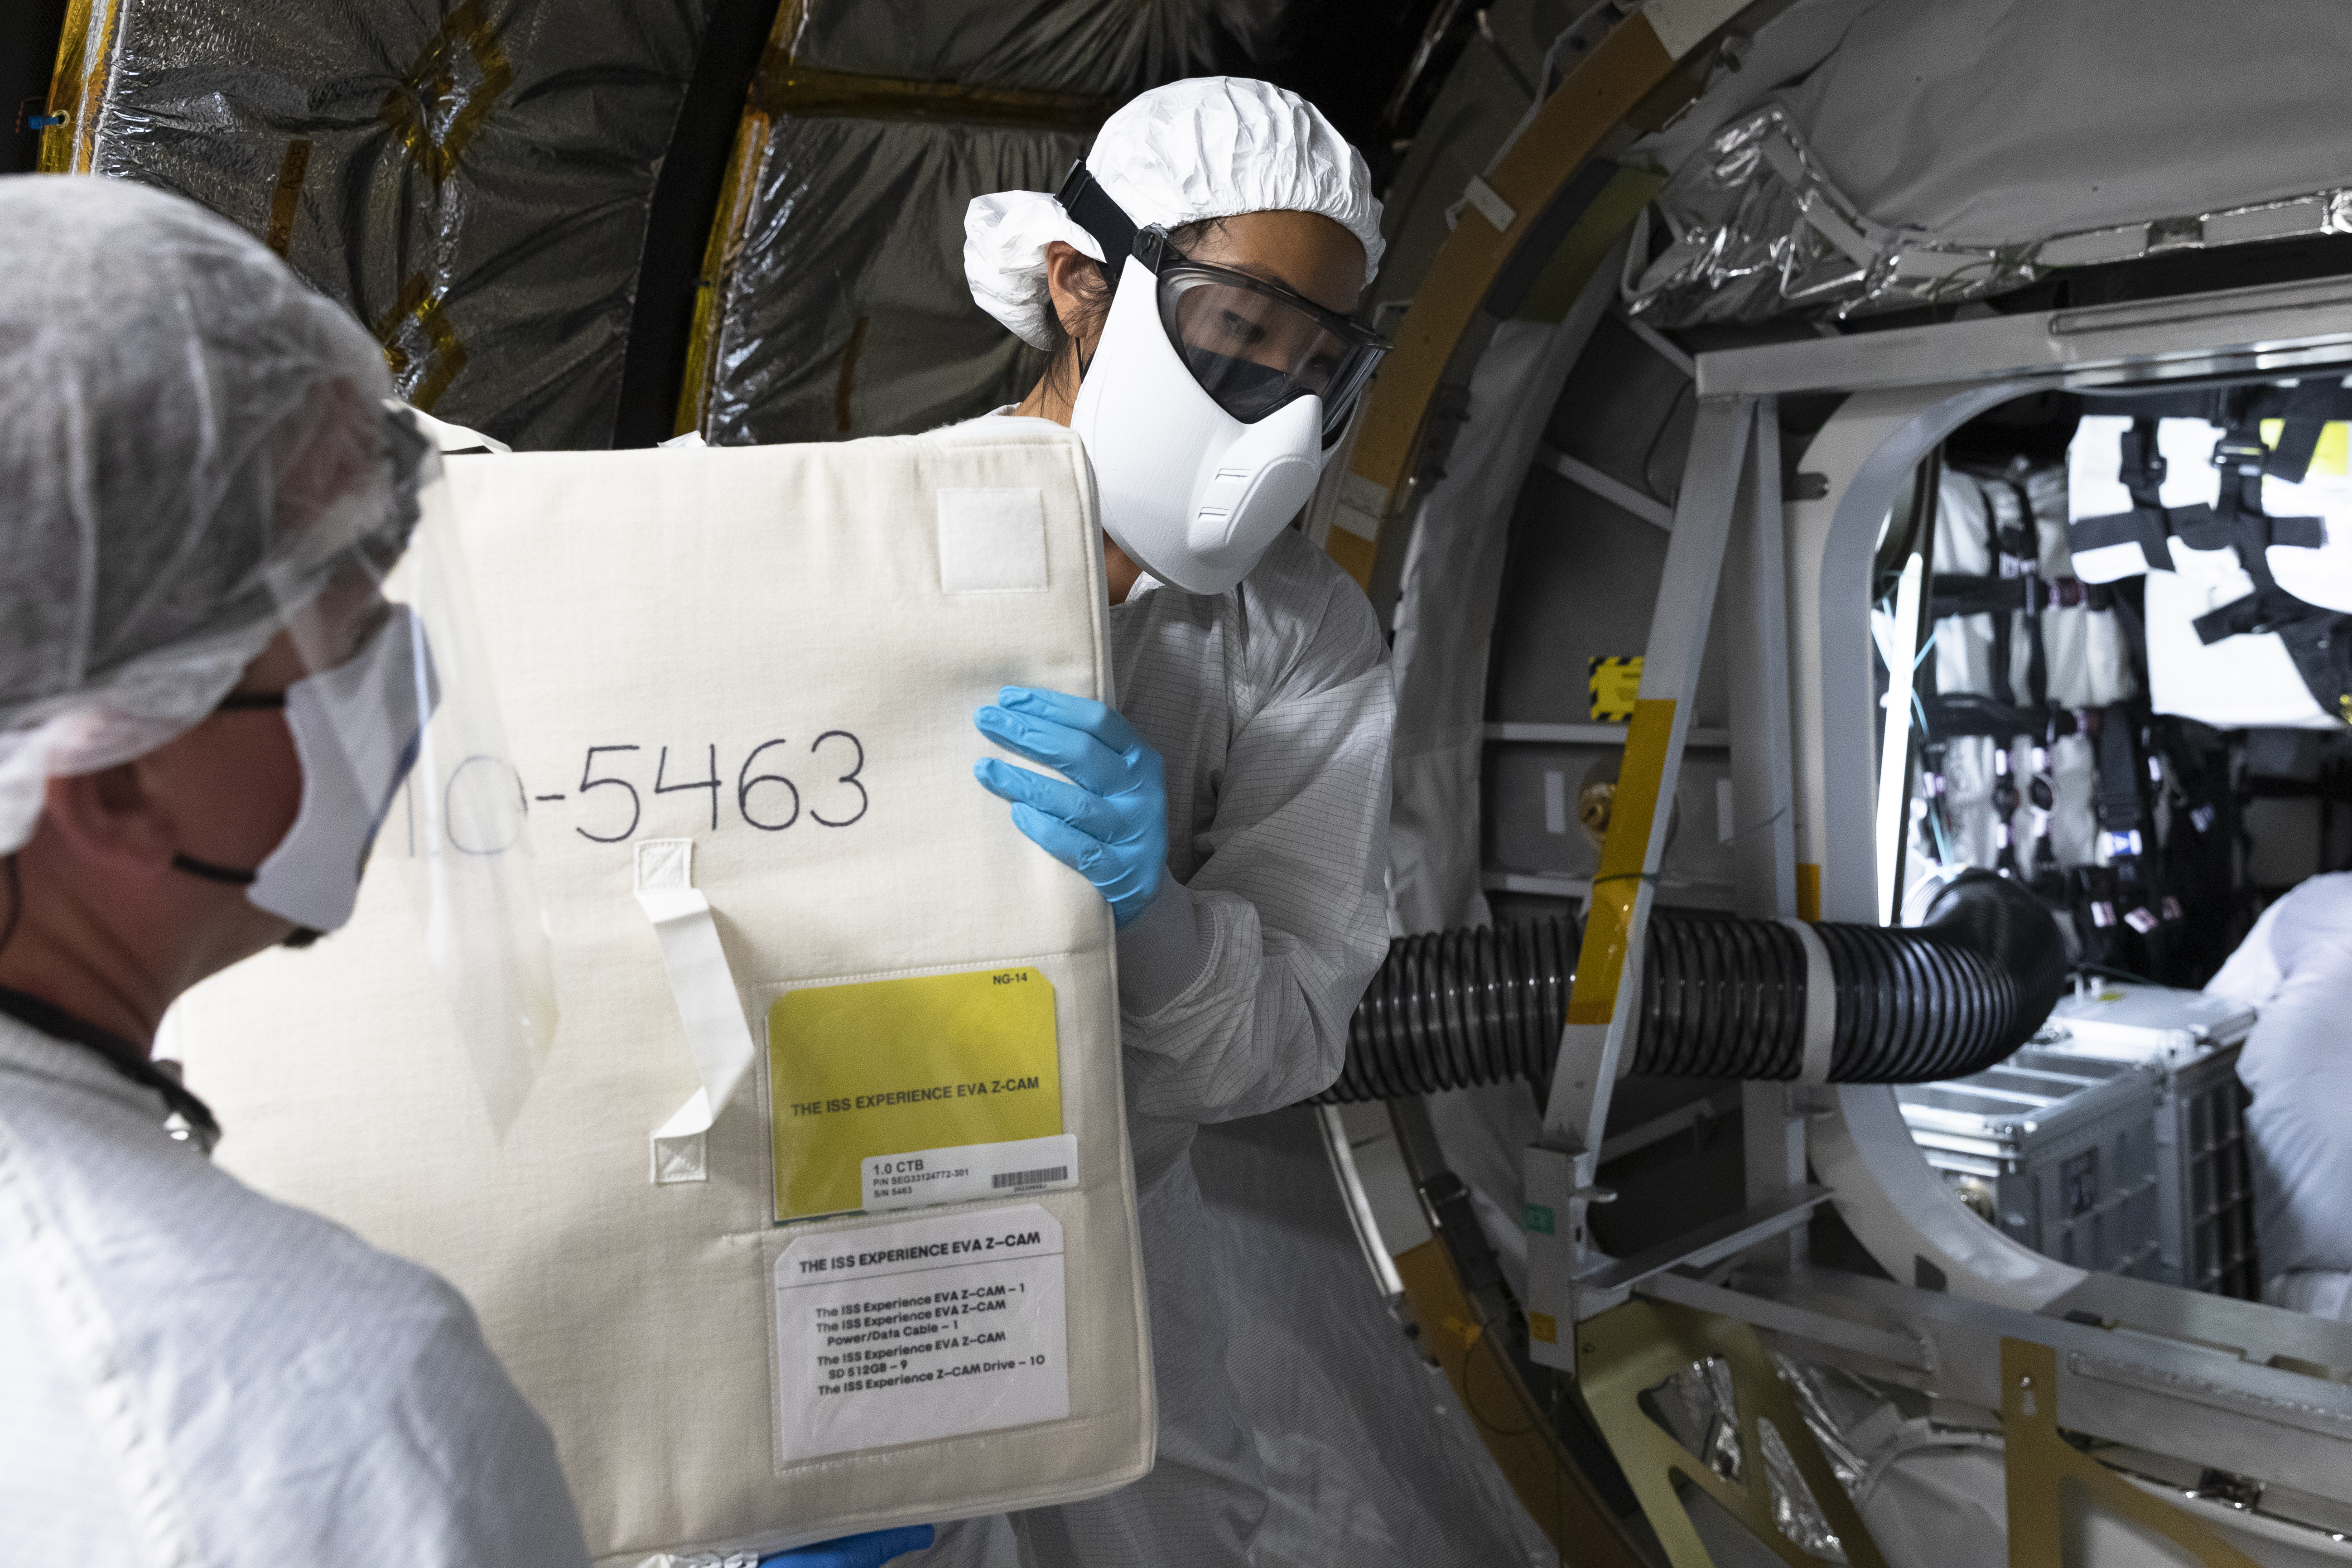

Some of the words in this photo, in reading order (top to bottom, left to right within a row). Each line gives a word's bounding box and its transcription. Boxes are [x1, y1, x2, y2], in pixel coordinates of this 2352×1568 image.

[993, 972, 1027, 985] NG-14
[790, 1101, 822, 1116] THE
[826, 1098, 851, 1112] ISS
[855, 1086, 952, 1109] EXPERIENCE
[957, 1082, 988, 1097] EVA
[991, 1076, 1039, 1093] Z-CAM
[873, 1163, 892, 1175] 1.0
[896, 1158, 924, 1173] CTB
[873, 1189, 889, 1198] S/N
[799, 1258, 827, 1273] THE
[831, 1254, 855, 1269] ISS
[858, 1243, 949, 1266] EXPERIENCE
[952, 1239, 982, 1254] EVA
[816, 1307, 838, 1318] The
[842, 1303, 860, 1315] ISS
[863, 1297, 931, 1312] Experience
[935, 1291, 958, 1303] EVA
[1020, 1283, 1024, 1293] 1
[816, 1322, 839, 1333] The
[842, 1317, 861, 1330] ISS
[864, 1311, 932, 1327] Experience
[935, 1305, 959, 1317] EVA
[827, 1329, 901, 1346] Power/Data
[903, 1323, 938, 1336] Cable
[954, 1320, 958, 1330] 1
[817, 1356, 839, 1366] The
[843, 1351, 862, 1363] ISS
[865, 1344, 932, 1360] Experience
[935, 1337, 959, 1350] EVA
[818, 1385, 841, 1396] The
[843, 1380, 863, 1392] ISS
[866, 1372, 934, 1389] Experience
[983, 1360, 1015, 1372] Drive
[1031, 1355, 1045, 1366] 10
[829, 1368, 845, 1380] SD
[848, 1362, 887, 1377] 512GB
[900, 1359, 907, 1370] 9
